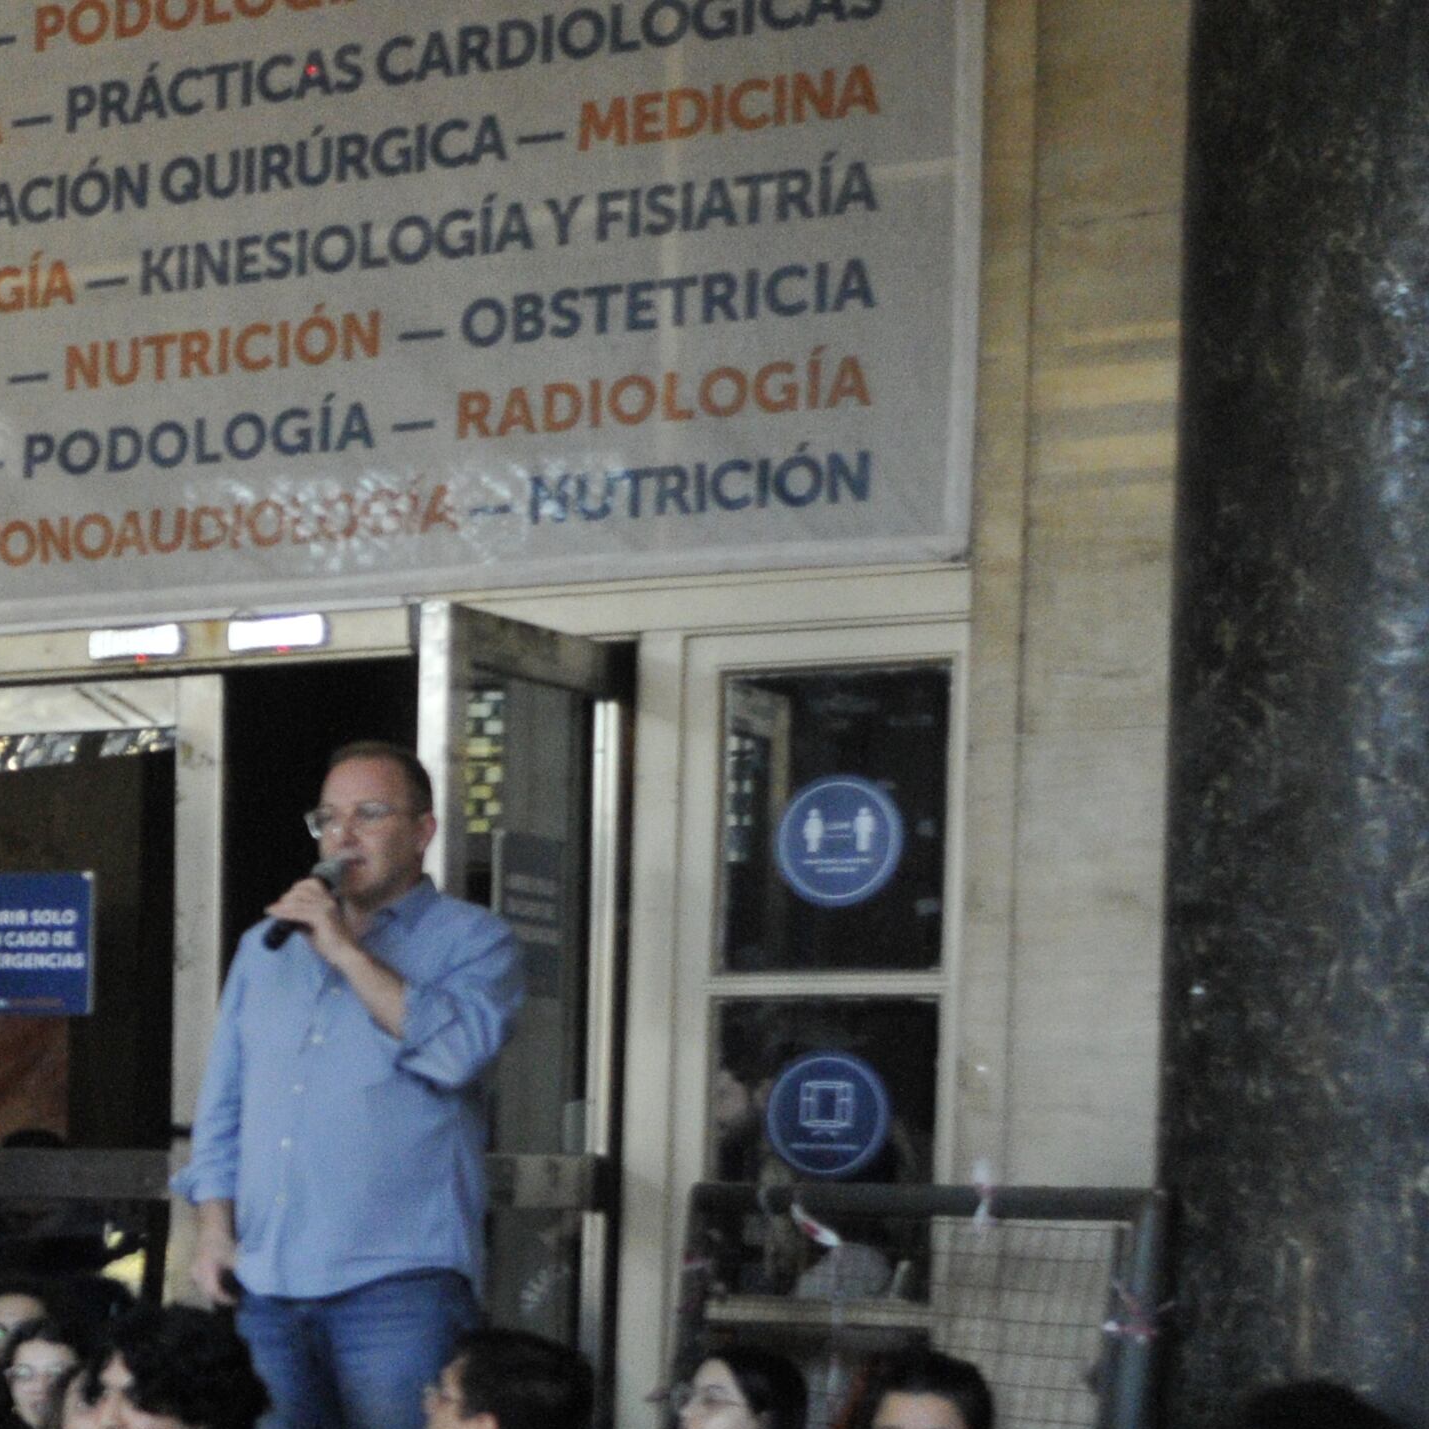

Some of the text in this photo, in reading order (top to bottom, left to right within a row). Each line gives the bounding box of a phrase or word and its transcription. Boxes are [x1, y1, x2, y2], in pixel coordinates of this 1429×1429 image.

[66, 44, 364, 133] PRÁCTICAS
[160, 114, 507, 205] QUIRÚRGICA
[578, 64, 880, 151] MEDICINA
[140, 193, 534, 296] KINESIOLOGÍA
[547, 196, 584, 246] Y
[596, 151, 878, 242] FISIATRÍA
[66, 303, 381, 390] NUTRICIÓN
[461, 258, 876, 348] OBSTETRICIA
[24, 392, 375, 479] PODOLOGÍA
[456, 344, 872, 441] RADIOLOGÍA
[530, 442, 871, 525] NUTRICIÓN
[4, 931, 50, 947] CASO
[52, 931, 75, 947] DE
[31, 909, 78, 925] SOLO
